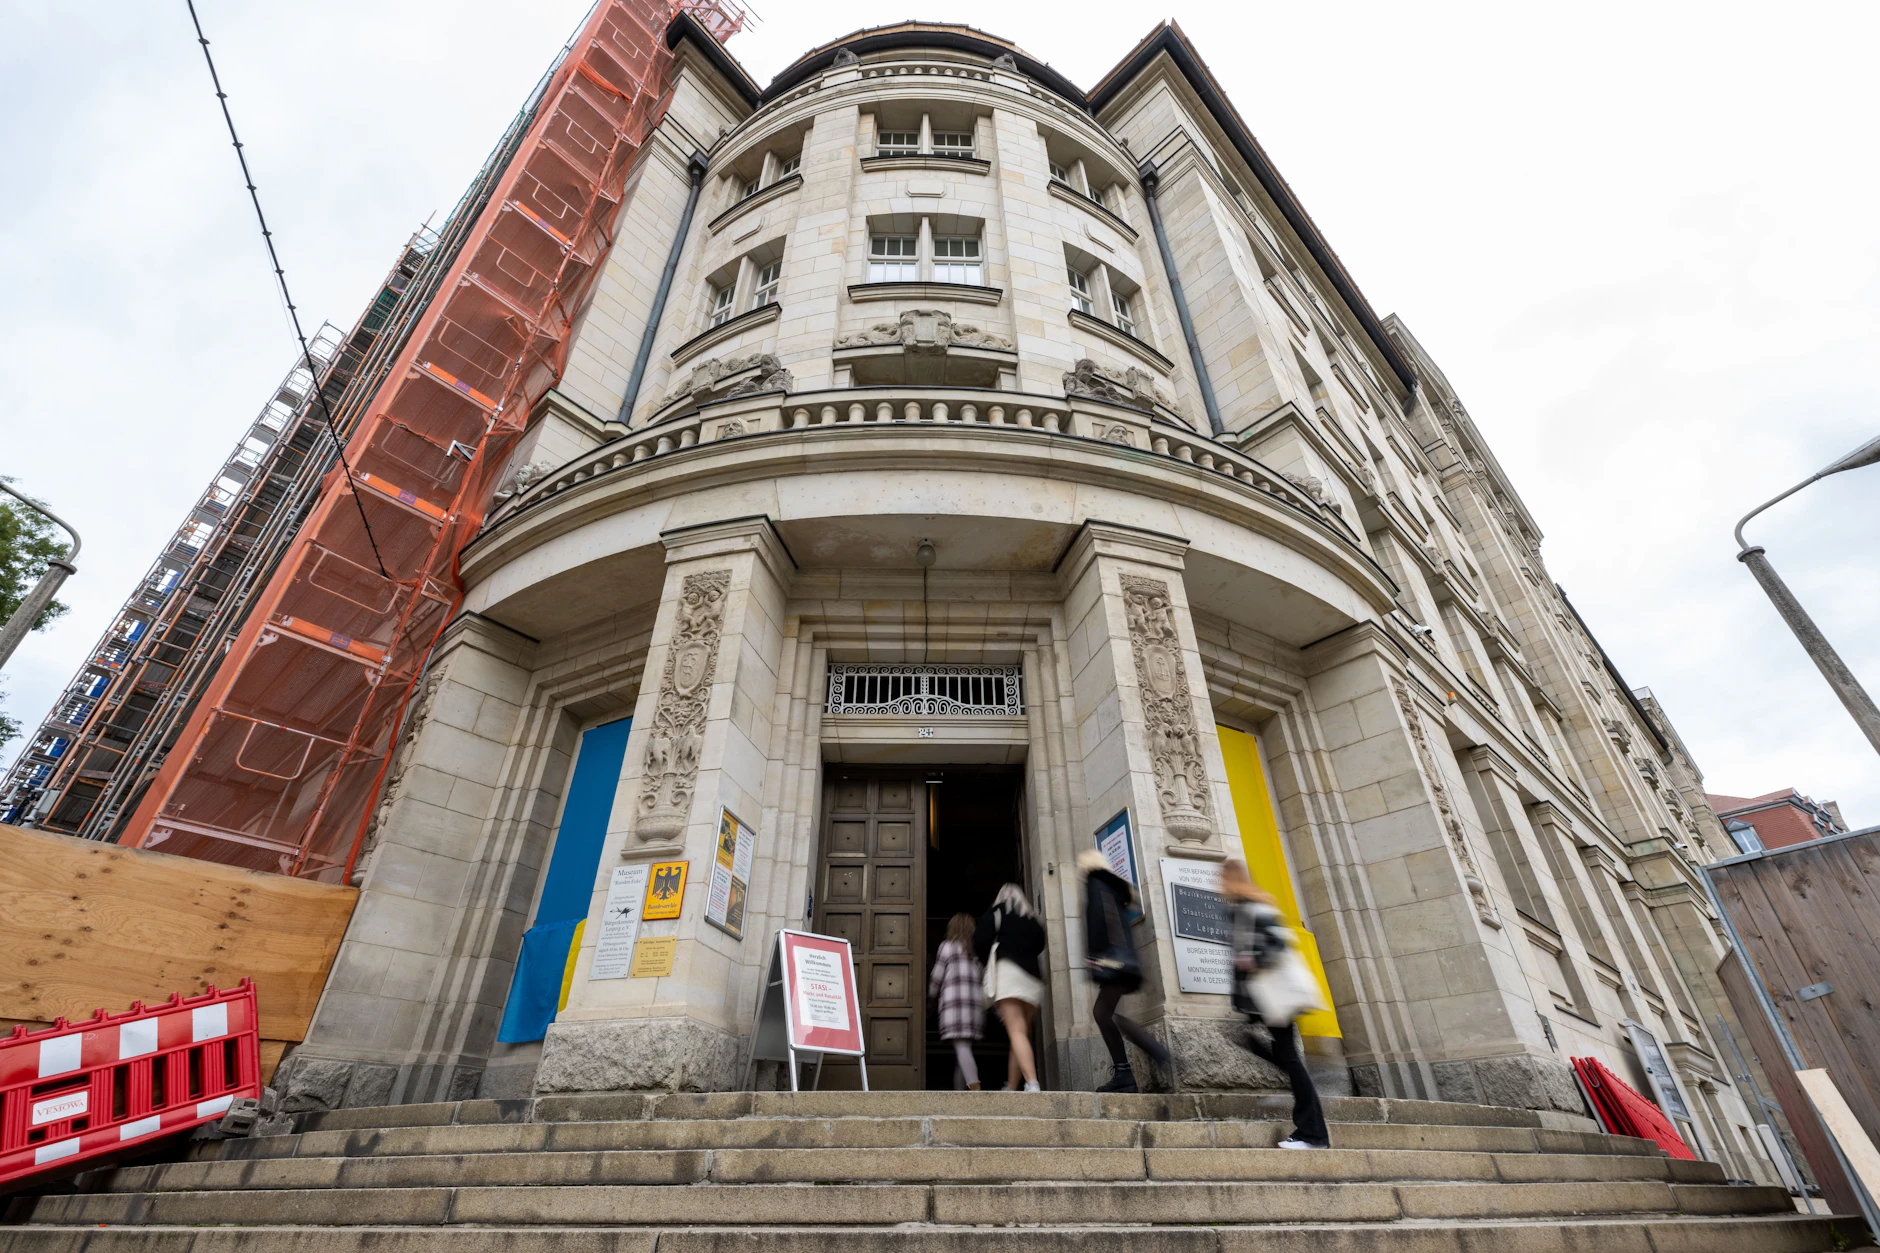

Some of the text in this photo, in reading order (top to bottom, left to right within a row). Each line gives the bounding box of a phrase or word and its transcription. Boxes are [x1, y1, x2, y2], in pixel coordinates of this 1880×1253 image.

[920, 728, 931, 736] 24
[1196, 922, 1228, 937] Leipzig
[805, 960, 832, 968] Willkommen
[1200, 957, 1226, 966] WÄHREND
[37, 1100, 84, 1116] VEMOWA
